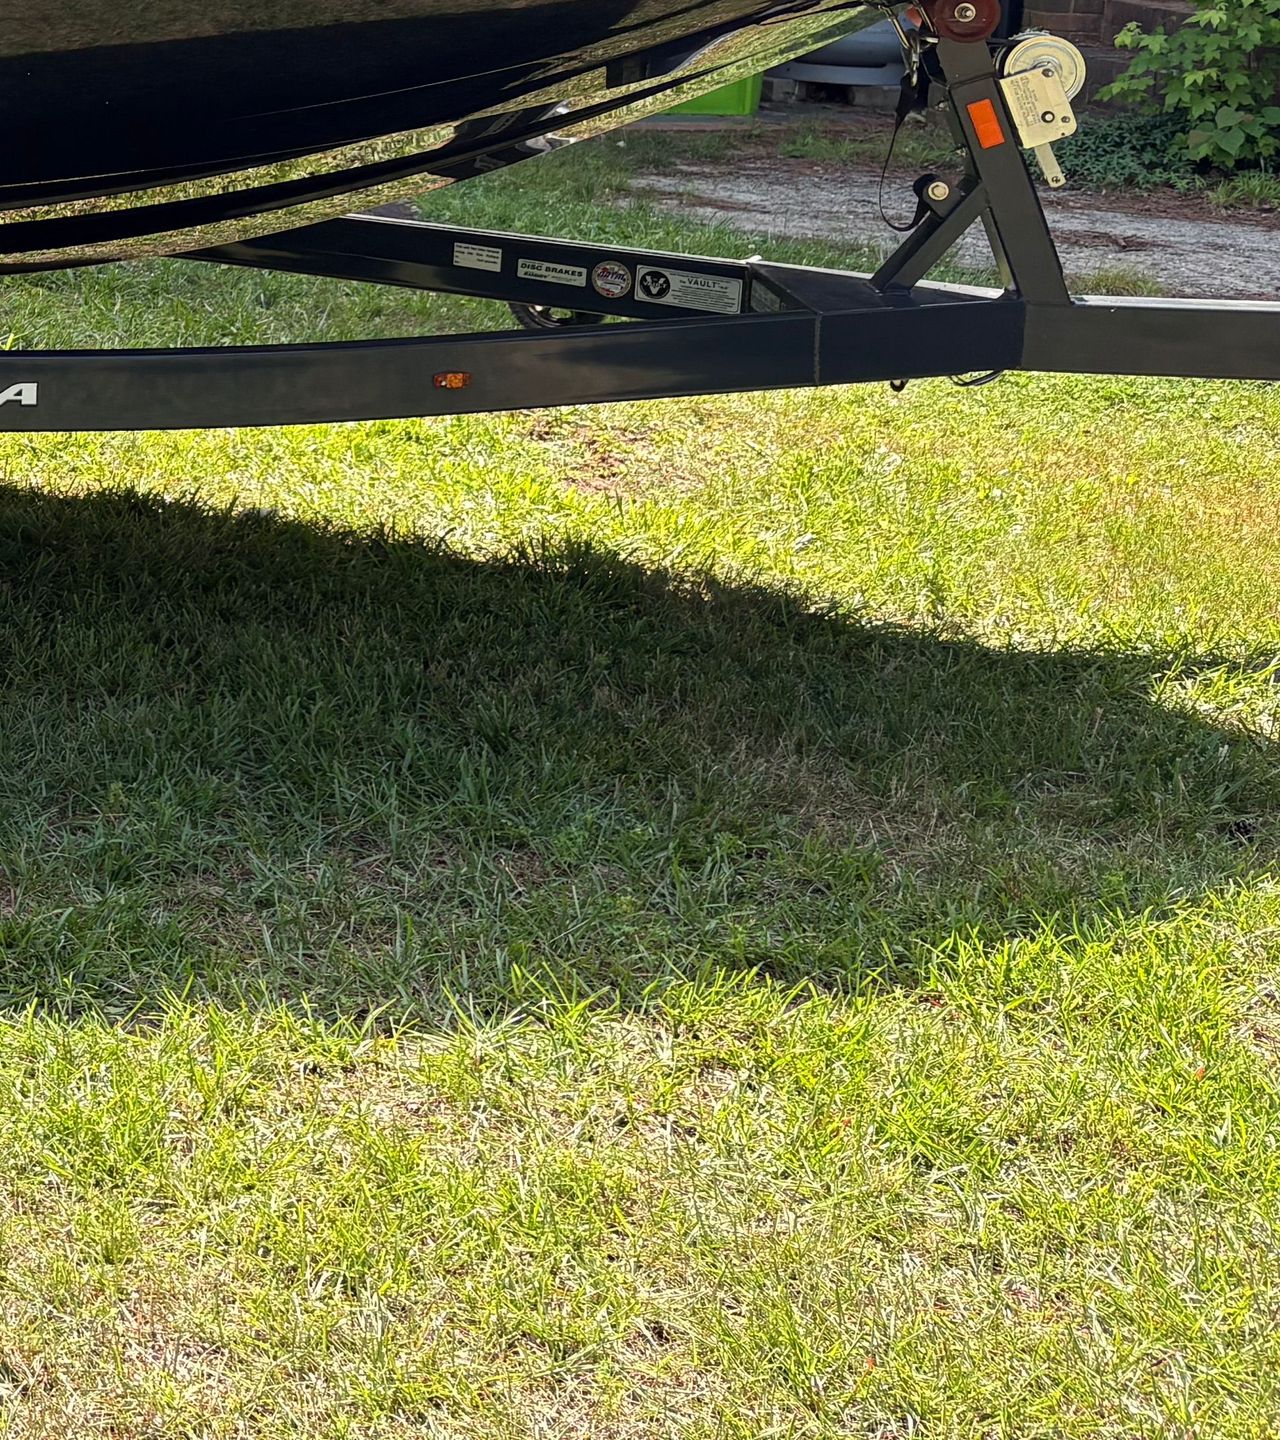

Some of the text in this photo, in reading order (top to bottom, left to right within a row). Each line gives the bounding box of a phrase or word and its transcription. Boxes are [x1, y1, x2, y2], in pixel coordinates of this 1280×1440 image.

[520, 262, 544, 272] DISC
[544, 266, 584, 278] BRAKES
[687, 278, 718, 289] VAULT
